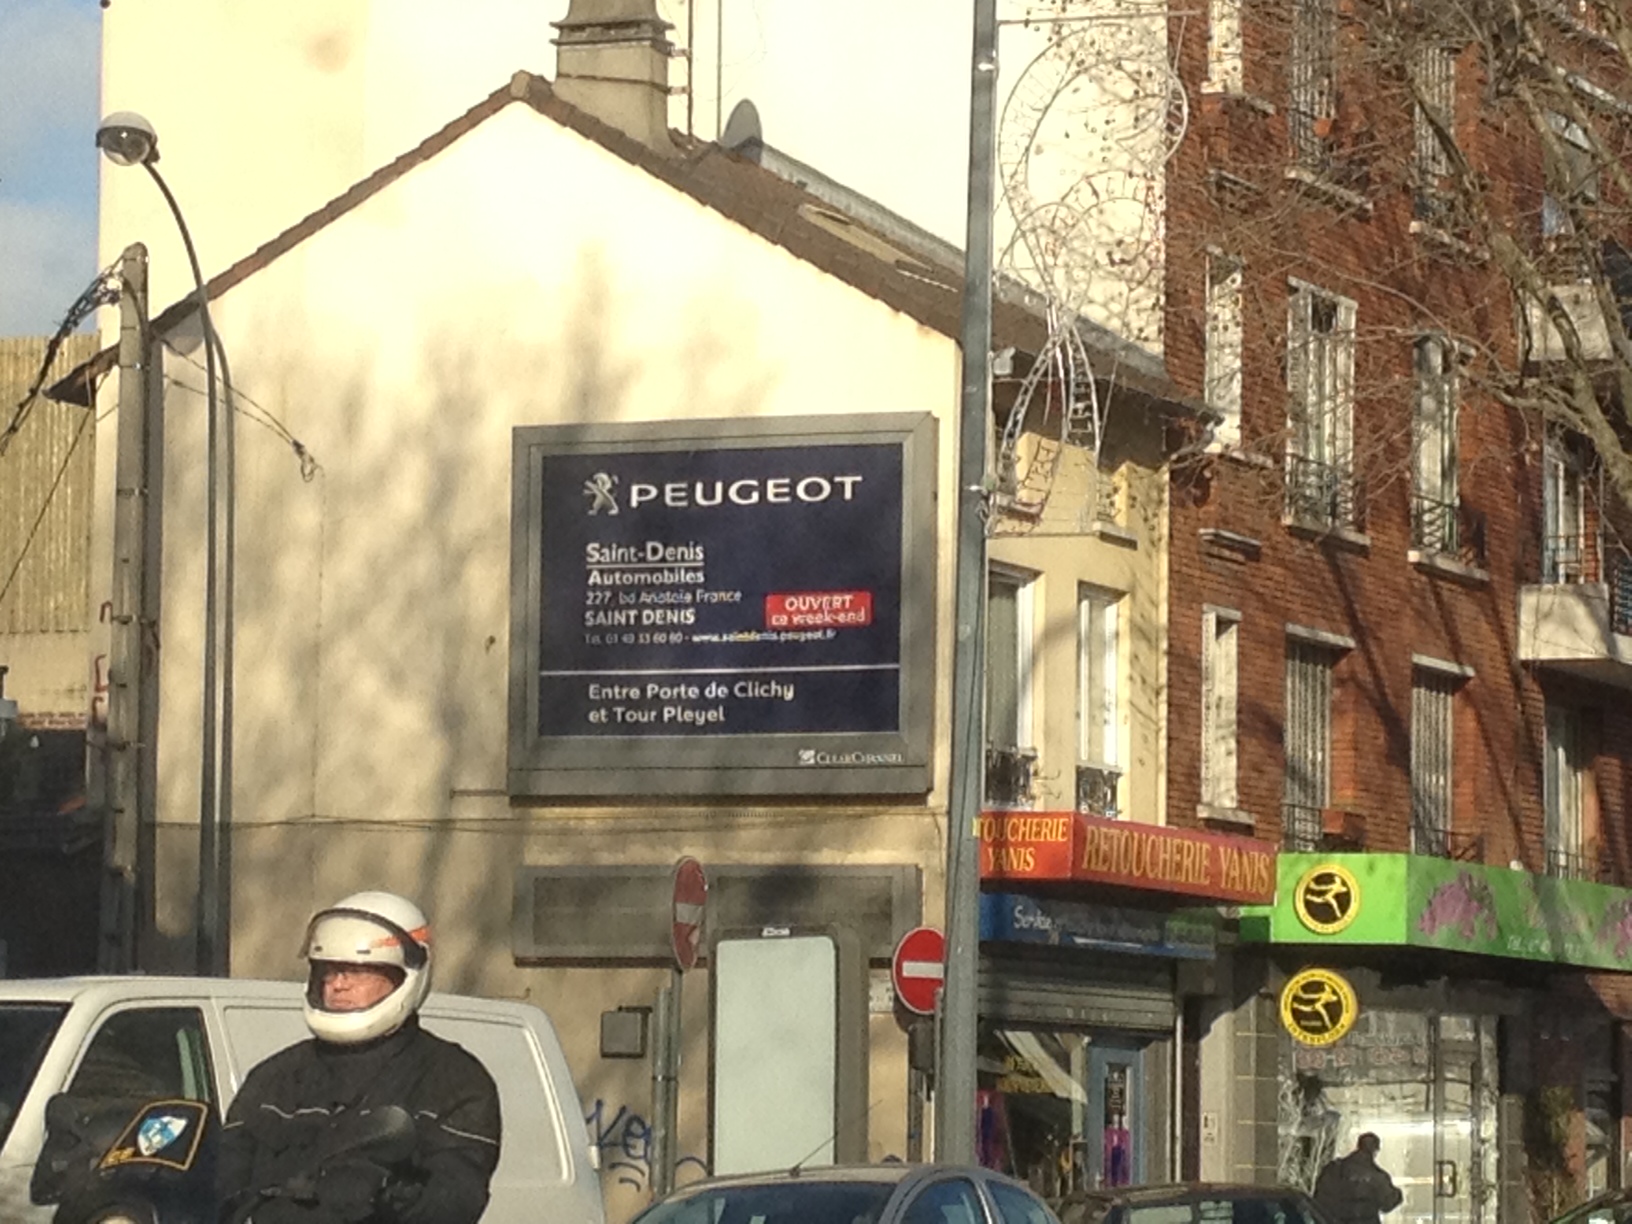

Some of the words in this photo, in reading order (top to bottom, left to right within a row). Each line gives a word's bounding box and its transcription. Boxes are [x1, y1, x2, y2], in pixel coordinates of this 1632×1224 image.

[630, 475, 863, 508] PEUGEOT
[586, 541, 704, 563] Saint-Denis
[588, 567, 705, 586] Automobiles
[696, 589, 742, 603] France
[785, 594, 852, 611] OUVERT
[584, 609, 638, 627] SAINT
[642, 608, 696, 625] DENIS
[792, 607, 866, 625] week-end
[588, 684, 640, 700] Entre
[646, 683, 699, 699] Porte
[704, 682, 729, 698] de
[733, 681, 795, 701] Clichy
[588, 708, 608, 723] et
[612, 707, 656, 722] Tour
[662, 706, 726, 726] Pleyel
[987, 847, 1036, 872] YANIS
[1081, 825, 1211, 885] RETOUCHERIE
[1218, 846, 1271, 894] YANIS
